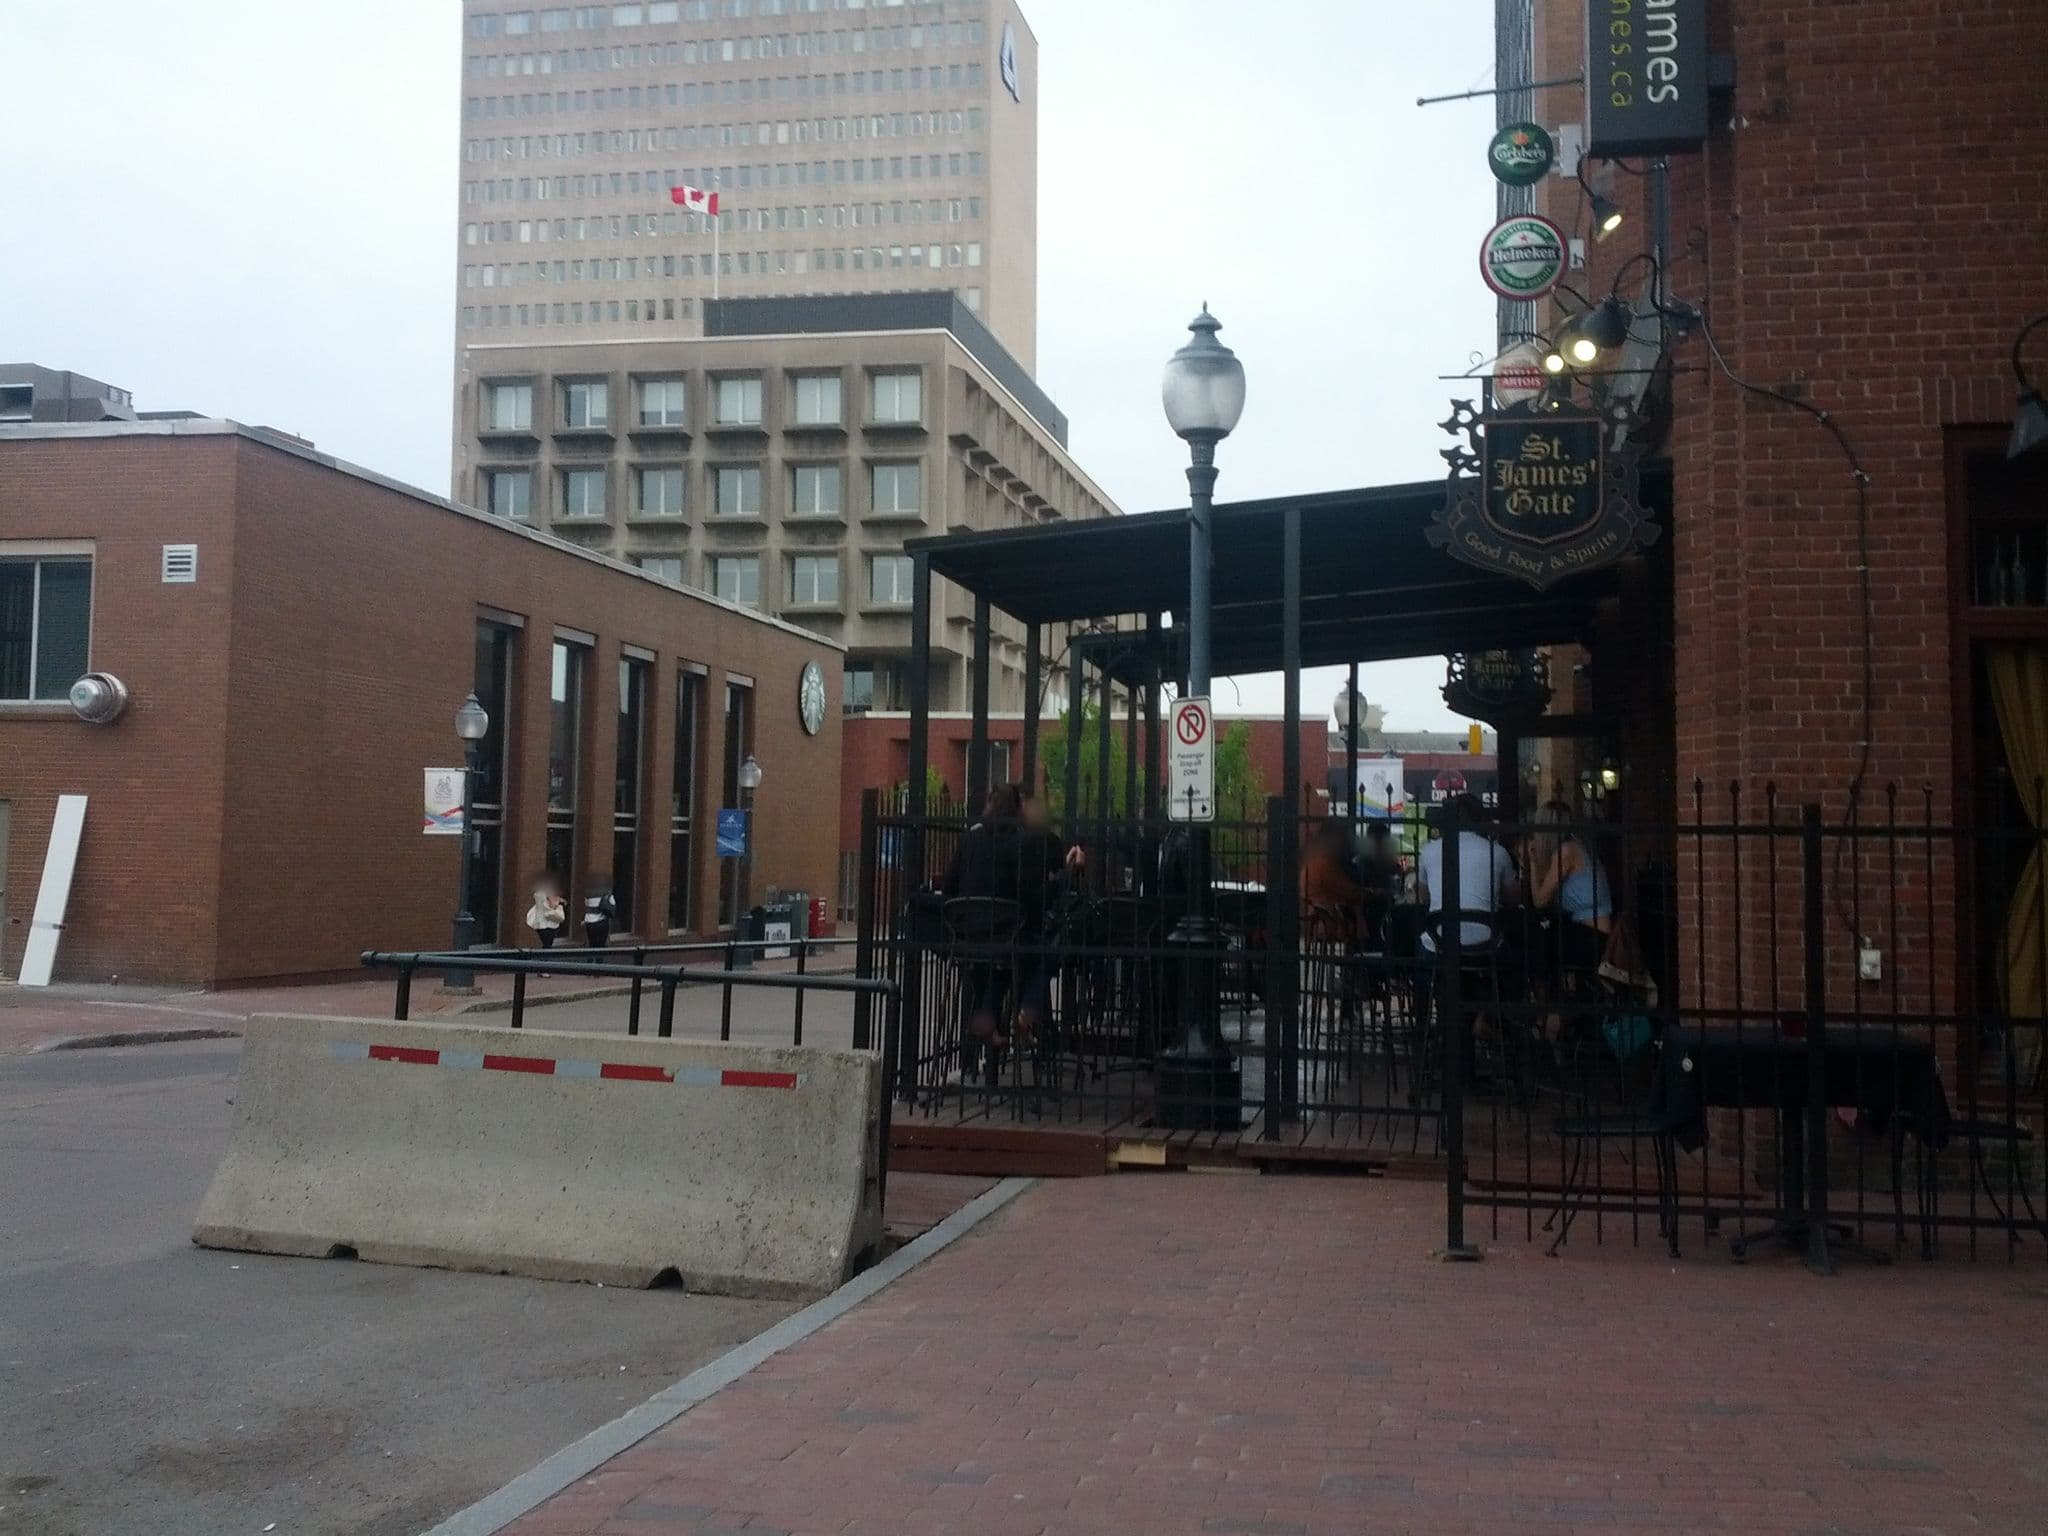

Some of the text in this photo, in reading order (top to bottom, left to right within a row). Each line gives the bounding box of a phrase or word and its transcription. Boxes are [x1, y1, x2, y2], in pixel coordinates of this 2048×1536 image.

[1493, 247, 1557, 263] Heineken
[1521, 433, 1570, 460] St.
[1505, 488, 1575, 515] Gate
[1465, 532, 1501, 559] Good
[1508, 551, 1543, 574] Food
[1566, 530, 1617, 562] Spirits
